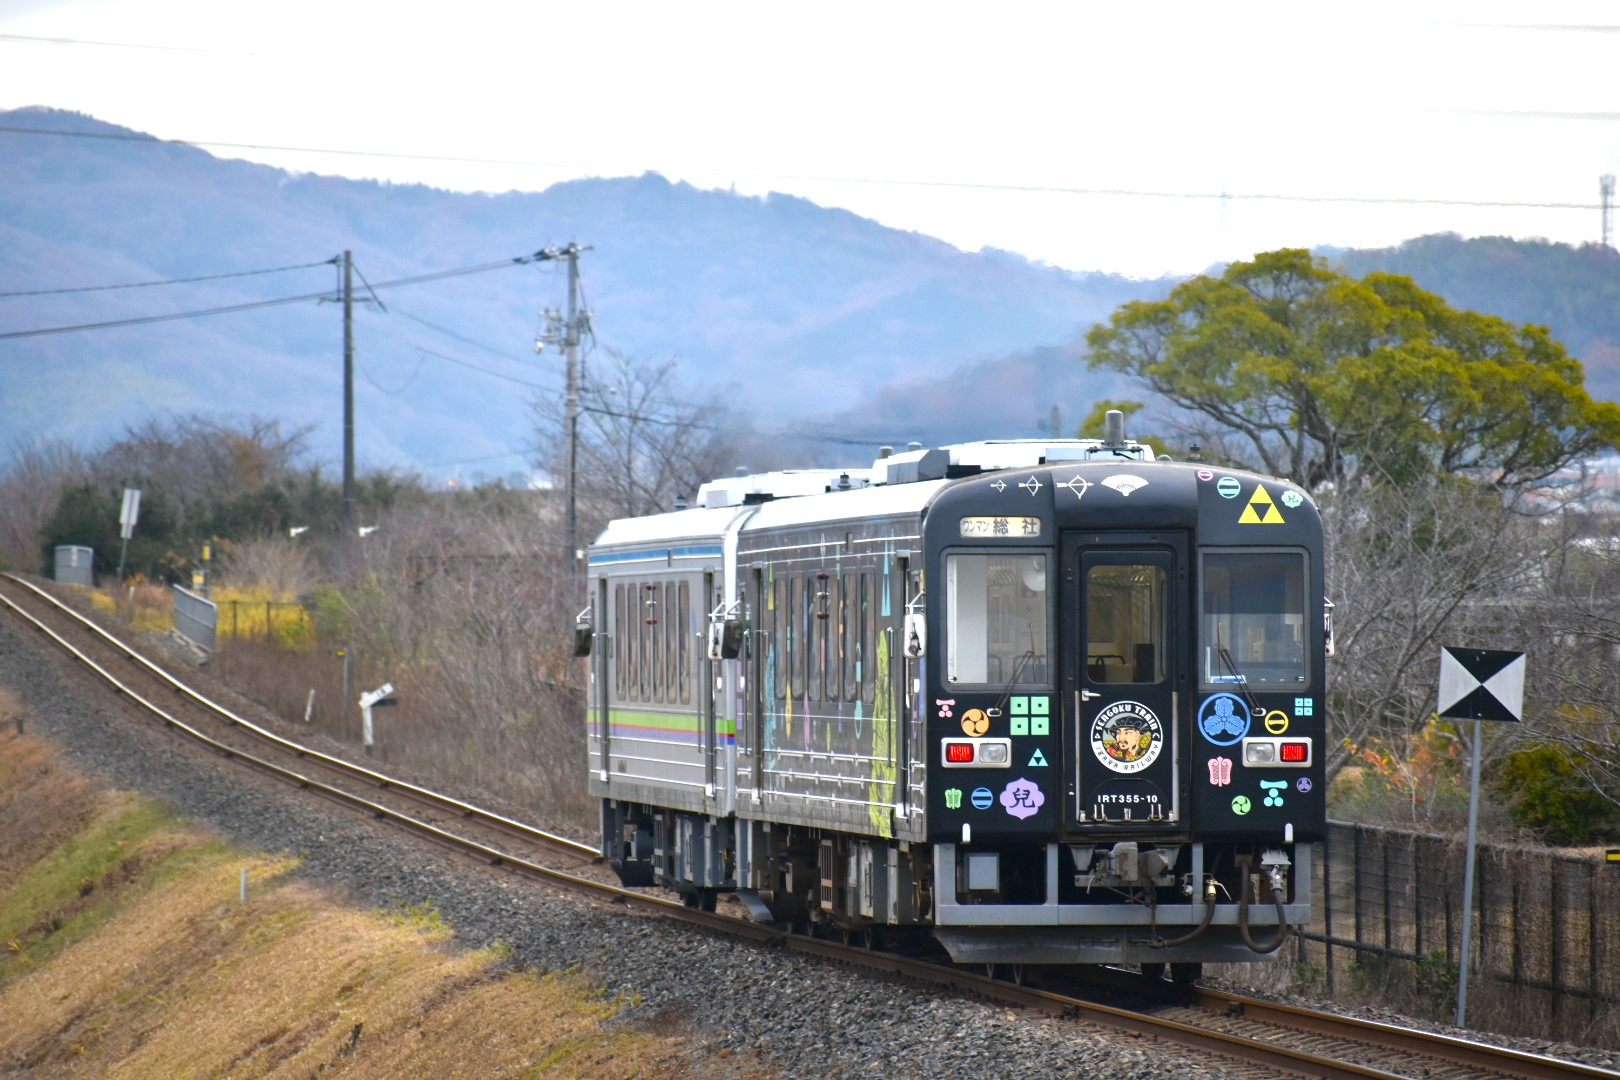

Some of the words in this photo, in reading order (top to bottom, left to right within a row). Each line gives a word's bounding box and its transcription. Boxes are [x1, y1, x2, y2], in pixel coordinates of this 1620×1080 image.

[962, 520, 989, 533] ワンマン
[993, 518, 1038, 535] 総社
[1095, 704, 1132, 731] SENGOKU
[1134, 705, 1158, 731] TRAIN
[1123, 744, 1159, 771] RAILWAY
[1097, 794, 1158, 804] IRT355-10
